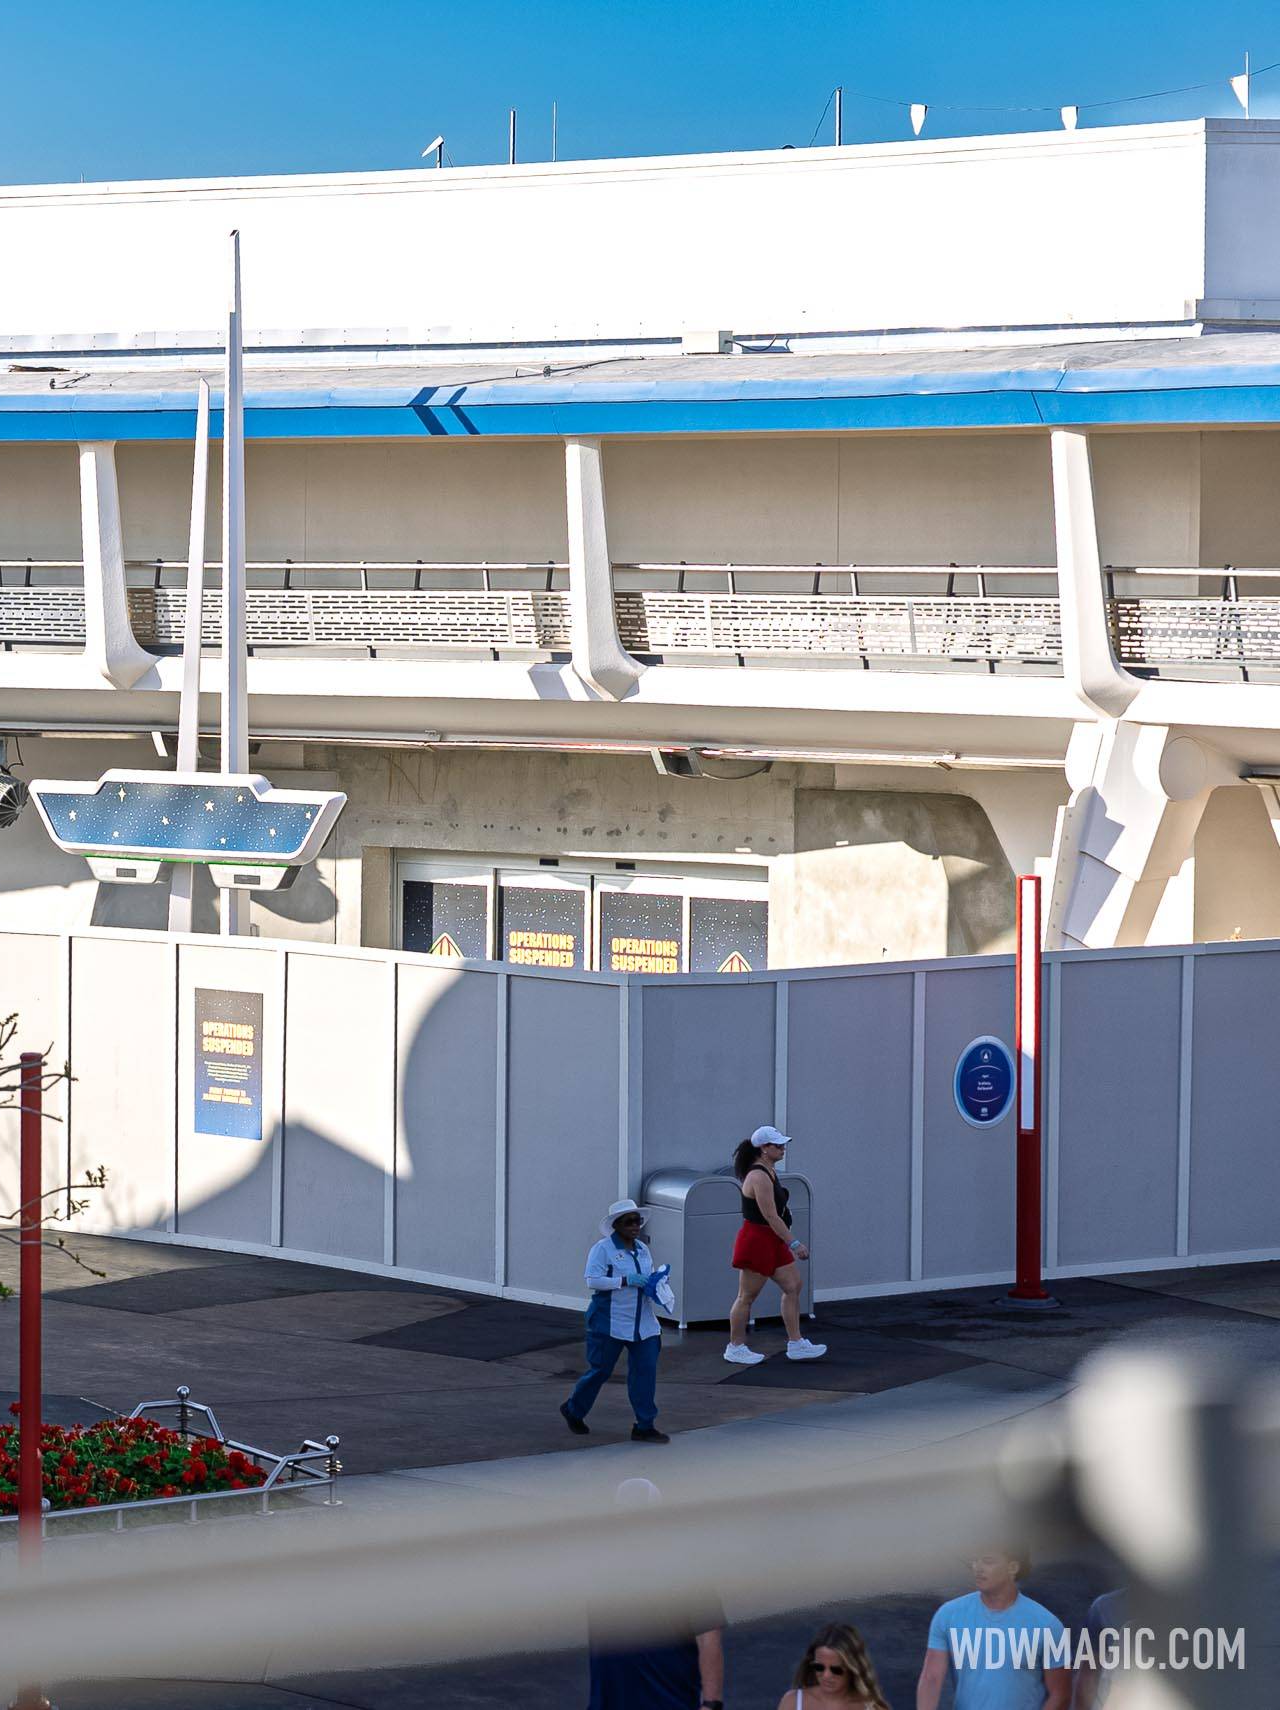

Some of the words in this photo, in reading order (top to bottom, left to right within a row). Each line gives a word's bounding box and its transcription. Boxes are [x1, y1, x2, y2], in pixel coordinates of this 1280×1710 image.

[508, 930, 575, 950] OPERATIONS
[611, 937, 678, 957] OPERATIONS
[508, 947, 575, 968] SUSPENDED
[610, 954, 678, 973] SUSPENDED
[202, 1021, 254, 1040] OPERATIONS
[202, 1036, 254, 1056] SUSPENDED
